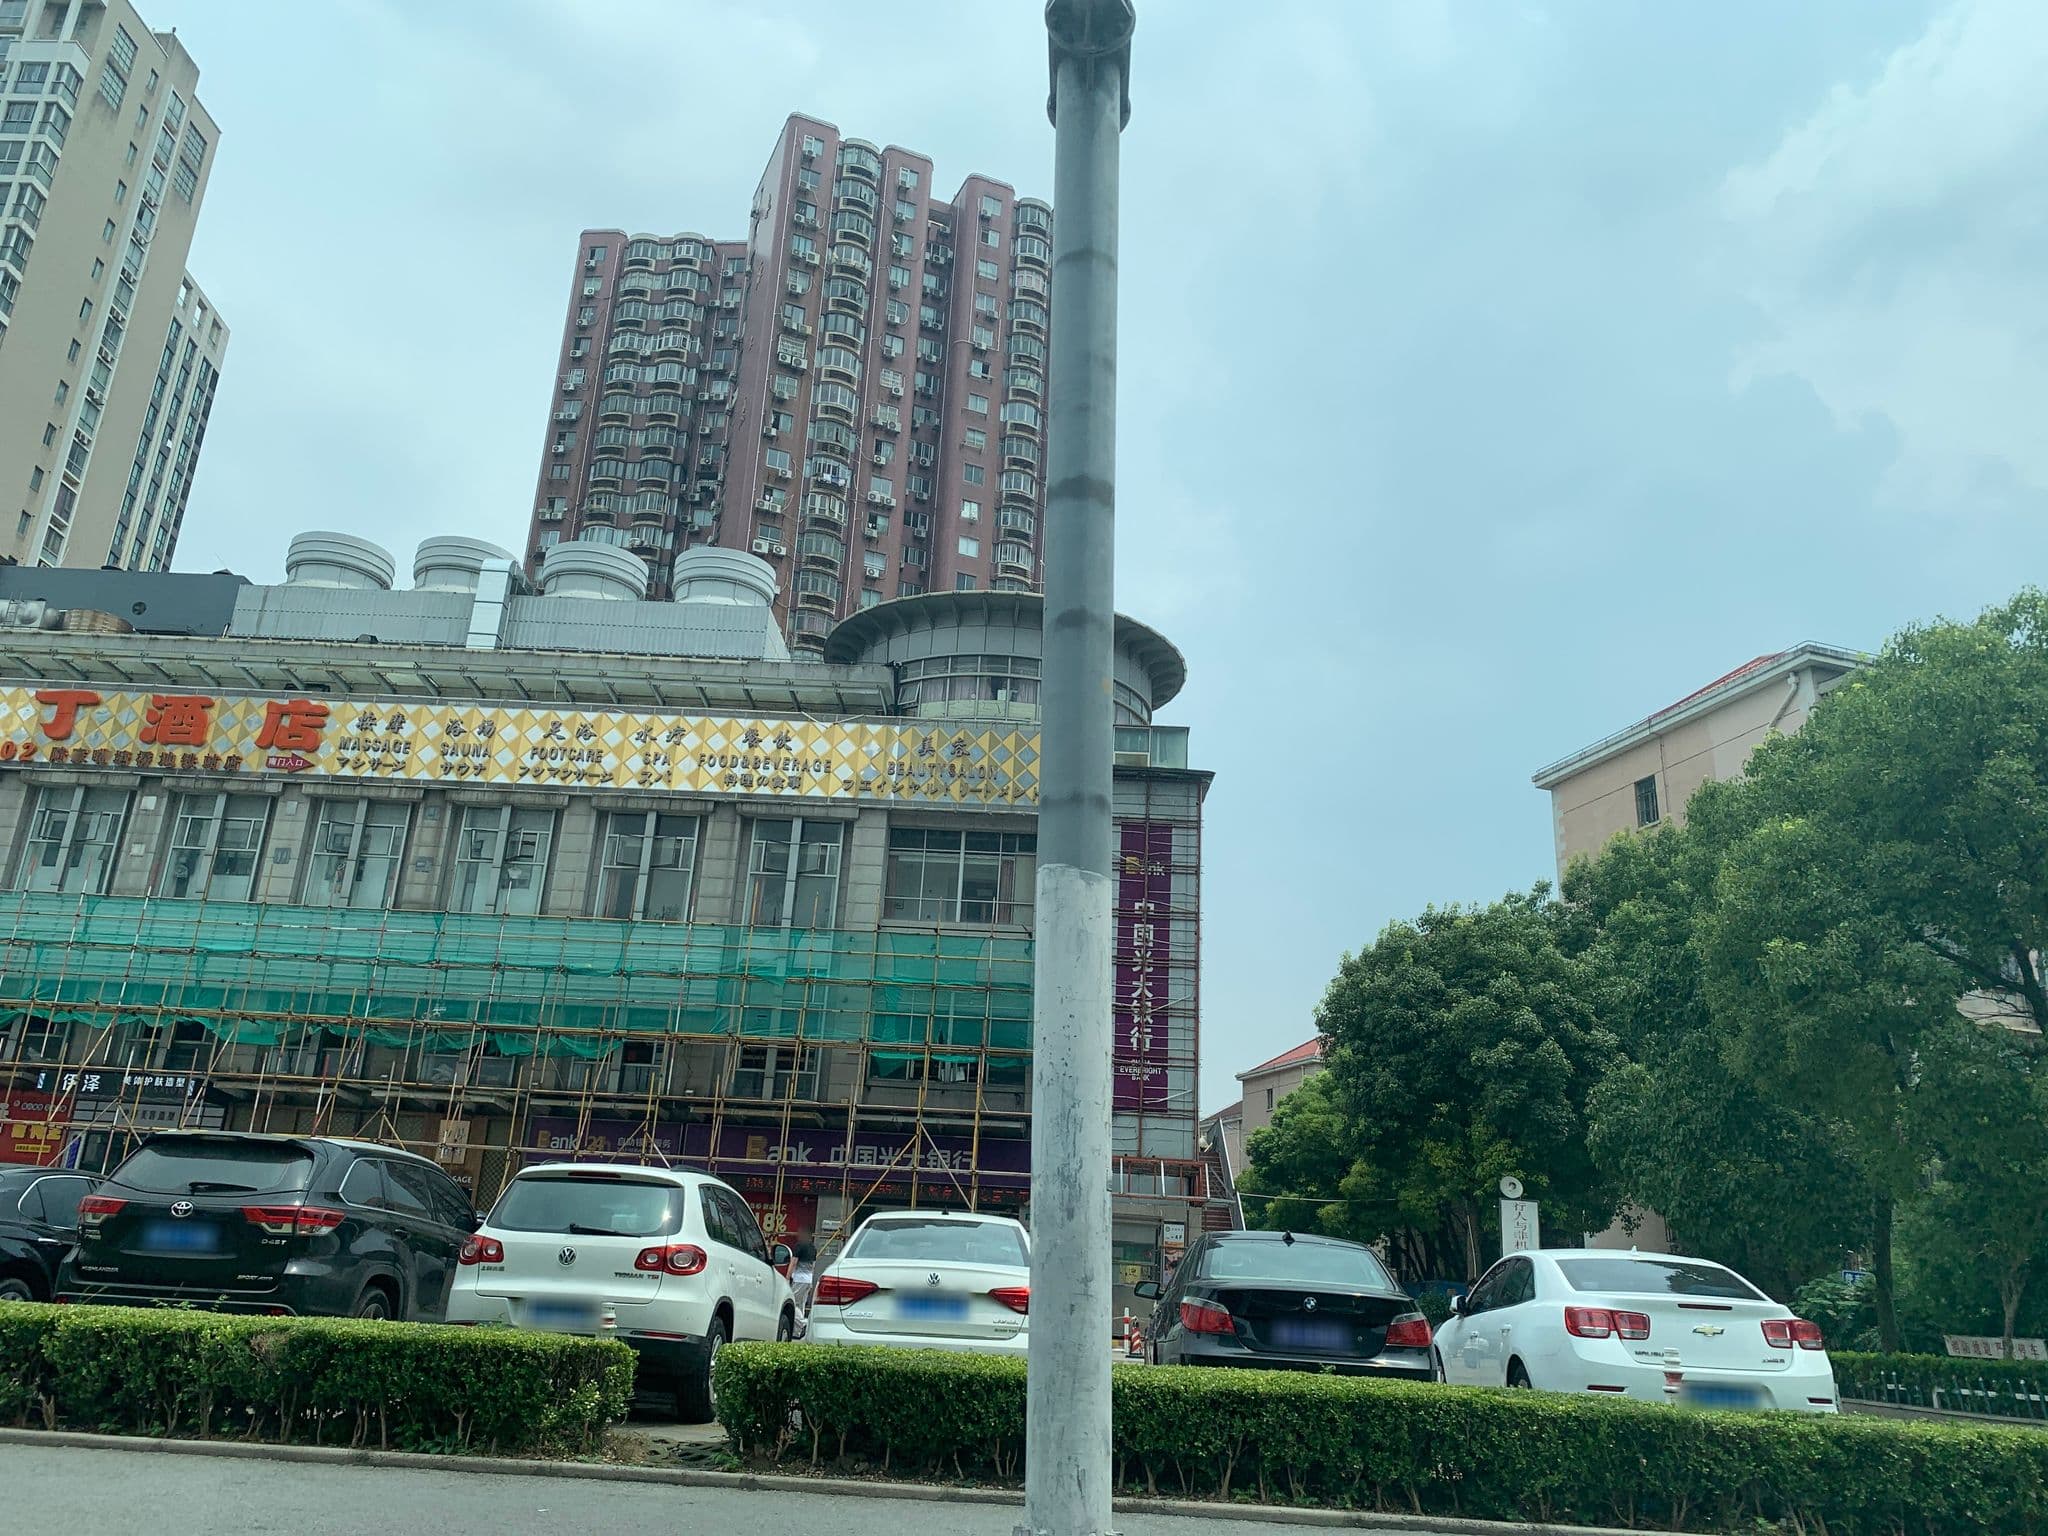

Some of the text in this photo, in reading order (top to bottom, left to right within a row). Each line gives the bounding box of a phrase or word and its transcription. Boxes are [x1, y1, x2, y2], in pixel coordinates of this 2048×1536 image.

[35, 690, 330, 752] 丁酒店
[355, 710, 407, 734] 按摩
[445, 718, 497, 739] 浴场
[543, 720, 598, 741] 足浴
[338, 735, 412, 755] MASSAGE
[635, 723, 686, 746] 水疗
[742, 728, 792, 751] 餐饮
[440, 742, 492, 758] SAUNA
[530, 745, 604, 764] FOOTCARE
[917, 736, 971, 757] 美容
[268, 757, 304, 767] 南门入口
[440, 761, 487, 777] サウナ
[643, 751, 671, 767] SPA
[1130, 898, 1156, 1052] 中国光大银行
[746, 1135, 814, 1163] Bank
[829, 1143, 979, 1170] 中国光大银行
